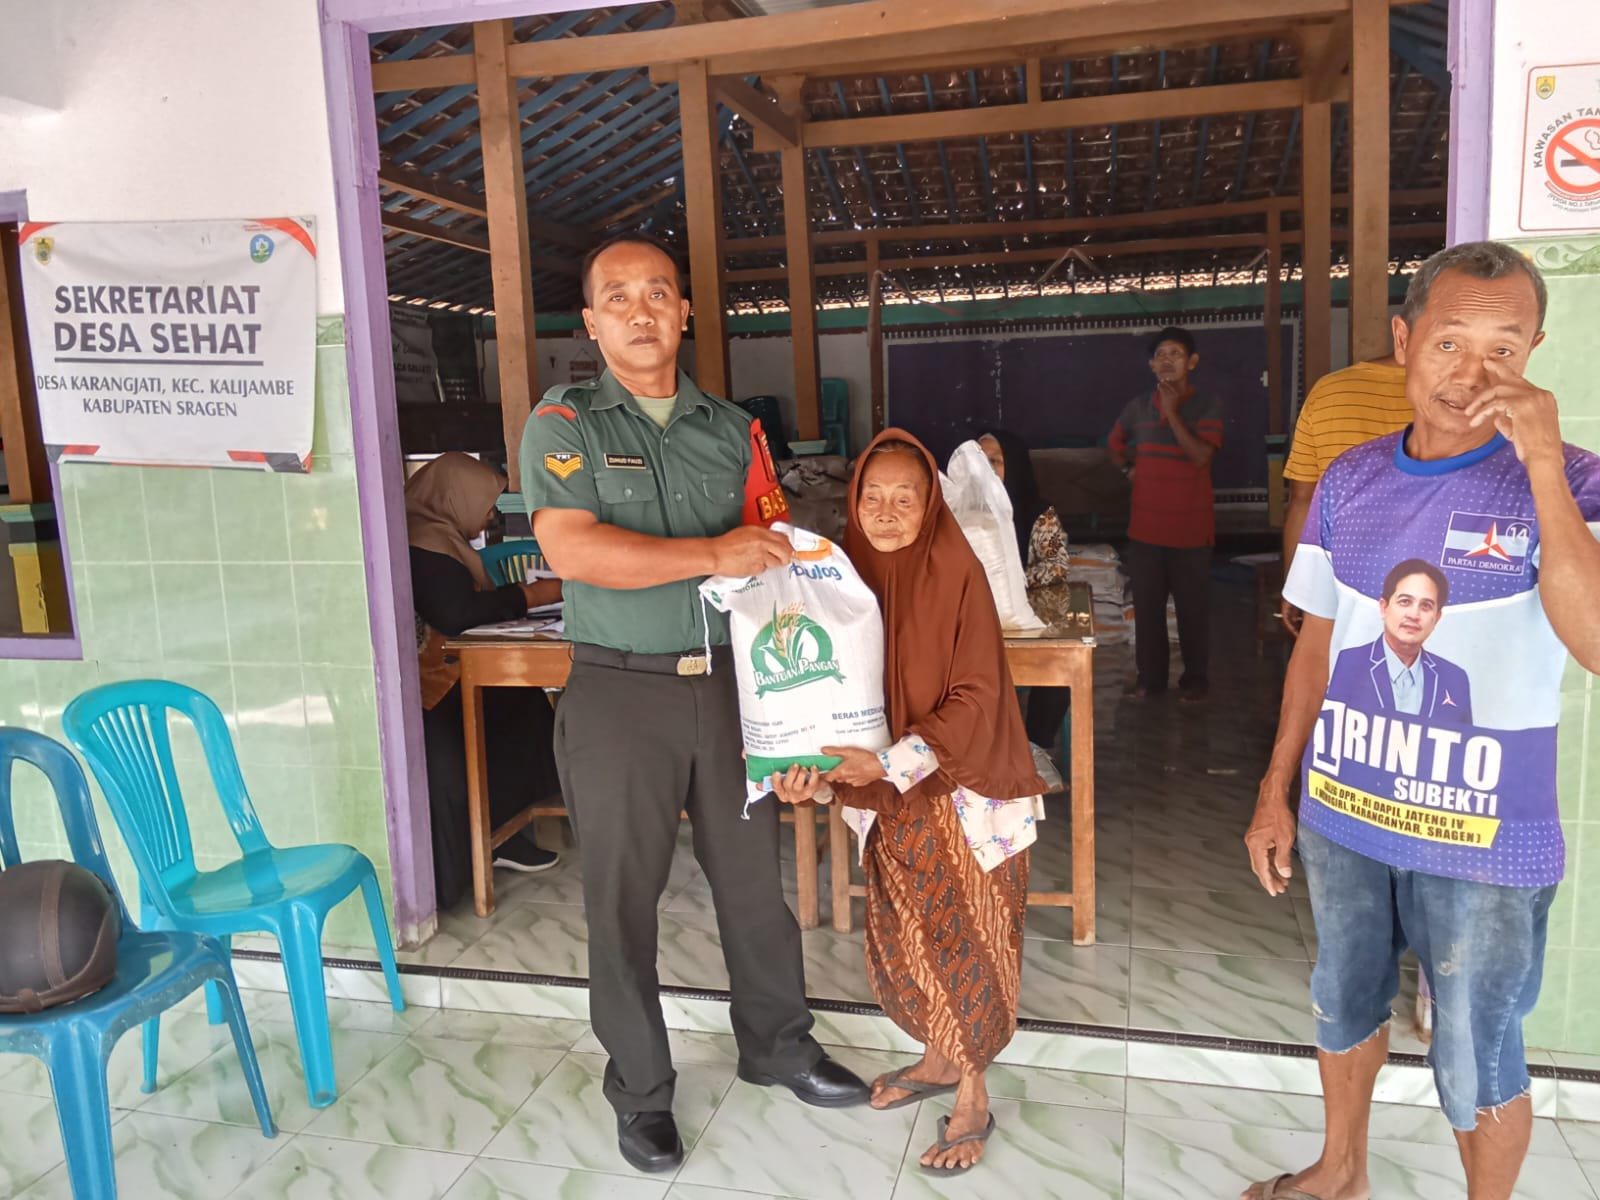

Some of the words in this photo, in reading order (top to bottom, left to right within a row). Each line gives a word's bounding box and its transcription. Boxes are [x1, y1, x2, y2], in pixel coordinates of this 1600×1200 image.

[1533, 112, 1573, 168] KAWASAN
[54, 285, 261, 315] SEKRETARIAT
[53, 322, 142, 353] DESA
[151, 322, 262, 354] SEHAT
[37, 375, 67, 391] DESA
[71, 376, 166, 395] KARANGJATI,
[172, 378, 204, 394] KEC.
[210, 379, 295, 397] KALIJAMBE
[83, 398, 172, 415] KABUPATEN
[177, 400, 238, 417] SRAGEN
[1510, 527, 1528, 541] 14
[1447, 557, 1477, 567] PARTAI
[832, 711, 859, 720] BERAS
[1343, 708, 1502, 791] RINTO
[1339, 789, 1356, 803] DPR
[1362, 797, 1372, 808] RI
[1373, 801, 1401, 818] DAPIL
[1405, 809, 1447, 827] JATENG
[1451, 818, 1465, 830] IV
[1393, 777, 1498, 816] SUBEKTI
[1350, 803, 1422, 835] KARANGANYAR,
[1427, 826, 1474, 843] SRAGEN
